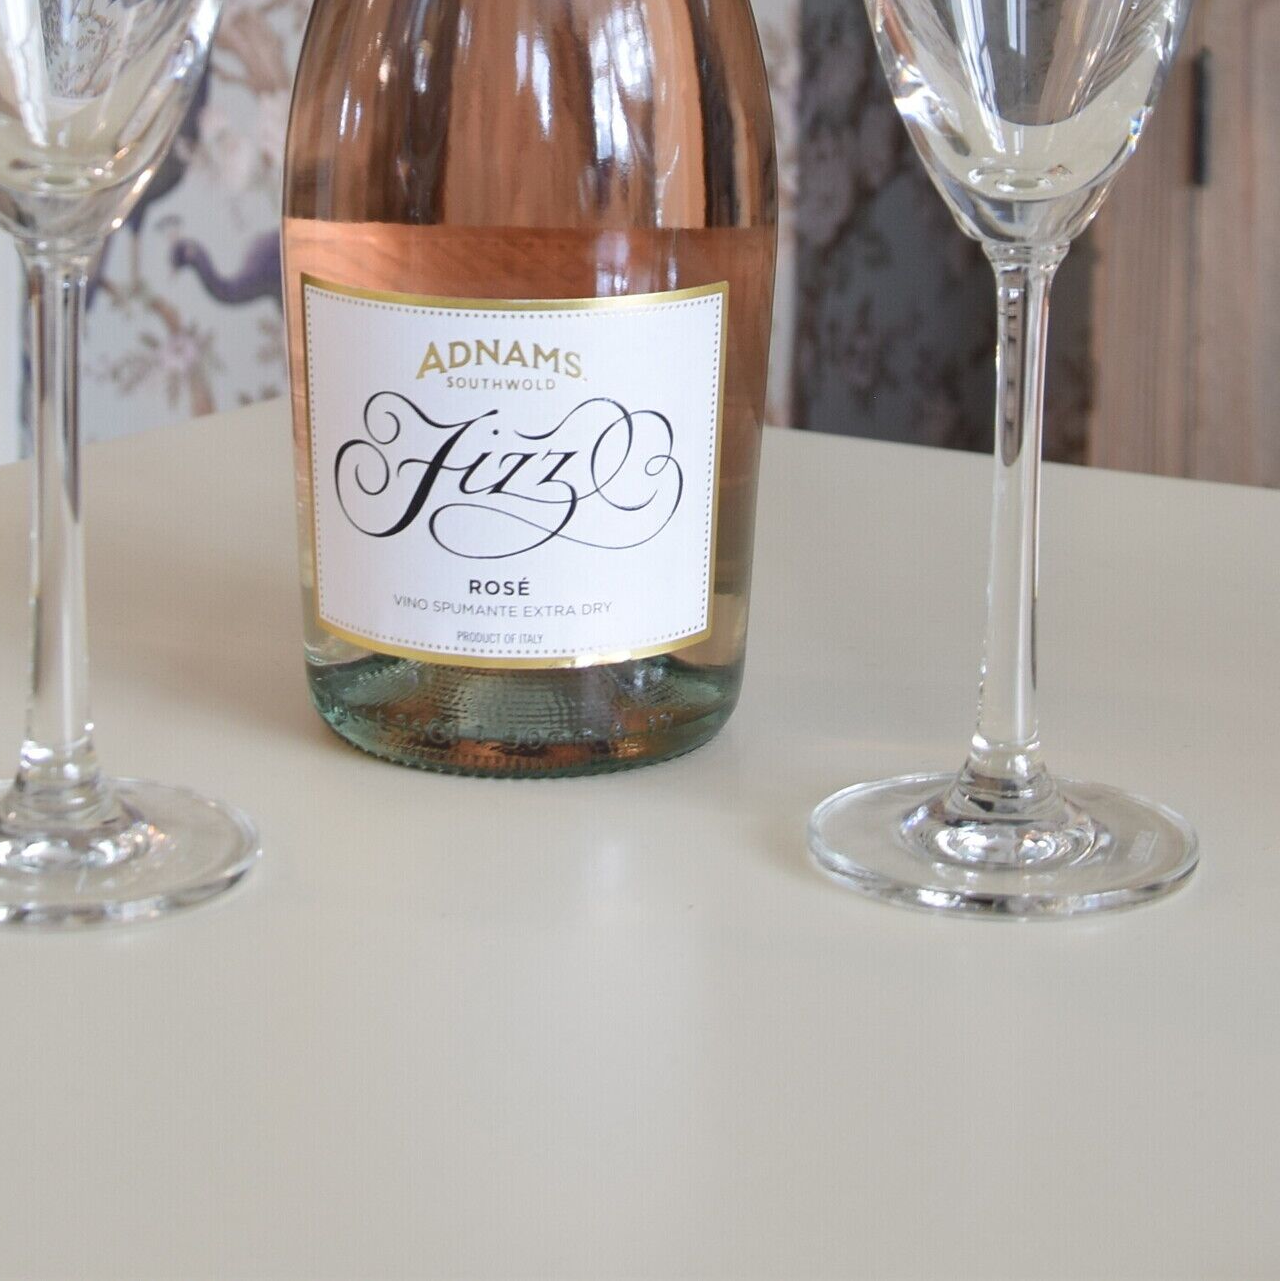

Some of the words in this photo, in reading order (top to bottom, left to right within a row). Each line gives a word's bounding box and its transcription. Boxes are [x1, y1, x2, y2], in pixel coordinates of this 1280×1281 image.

[415, 339, 583, 380] ADNAMS
[446, 375, 557, 391] SOUTHWOLD
[334, 390, 683, 560] Fizz
[468, 576, 530, 596] ROSÉ
[393, 593, 428, 611] VINO
[432, 600, 518, 618] SPUMANTE
[523, 605, 577, 618] EXTRA
[581, 601, 613, 616] DRY
[456, 630, 501, 644] PRODUCT
[504, 632, 517, 645] OF
[519, 632, 544, 645] ITALY
